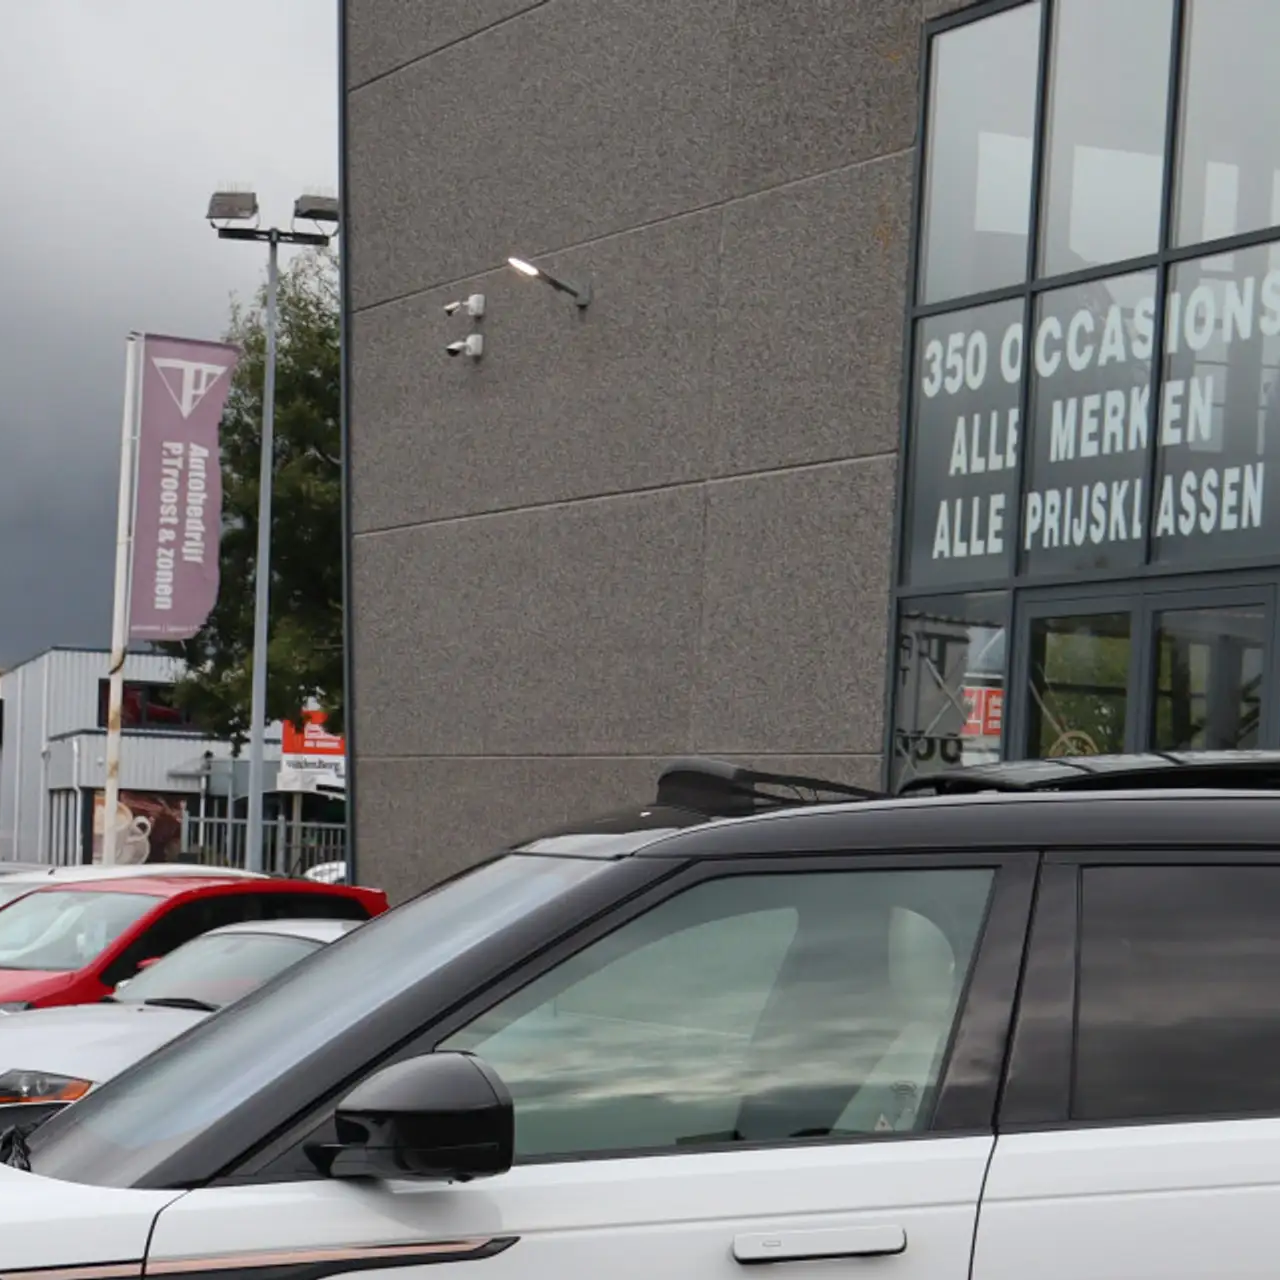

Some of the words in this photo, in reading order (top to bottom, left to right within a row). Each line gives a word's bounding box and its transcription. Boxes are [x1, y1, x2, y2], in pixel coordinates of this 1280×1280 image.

[923, 330, 987, 398] 350
[949, 408, 1018, 476] ALLE
[1050, 375, 1214, 463] MERKEN
[181, 442, 210, 565] Autobedrijf
[932, 493, 1006, 560] ALLE
[1024, 462, 1265, 551] PRIJSKLASSEN
[153, 548, 175, 611] zonen
